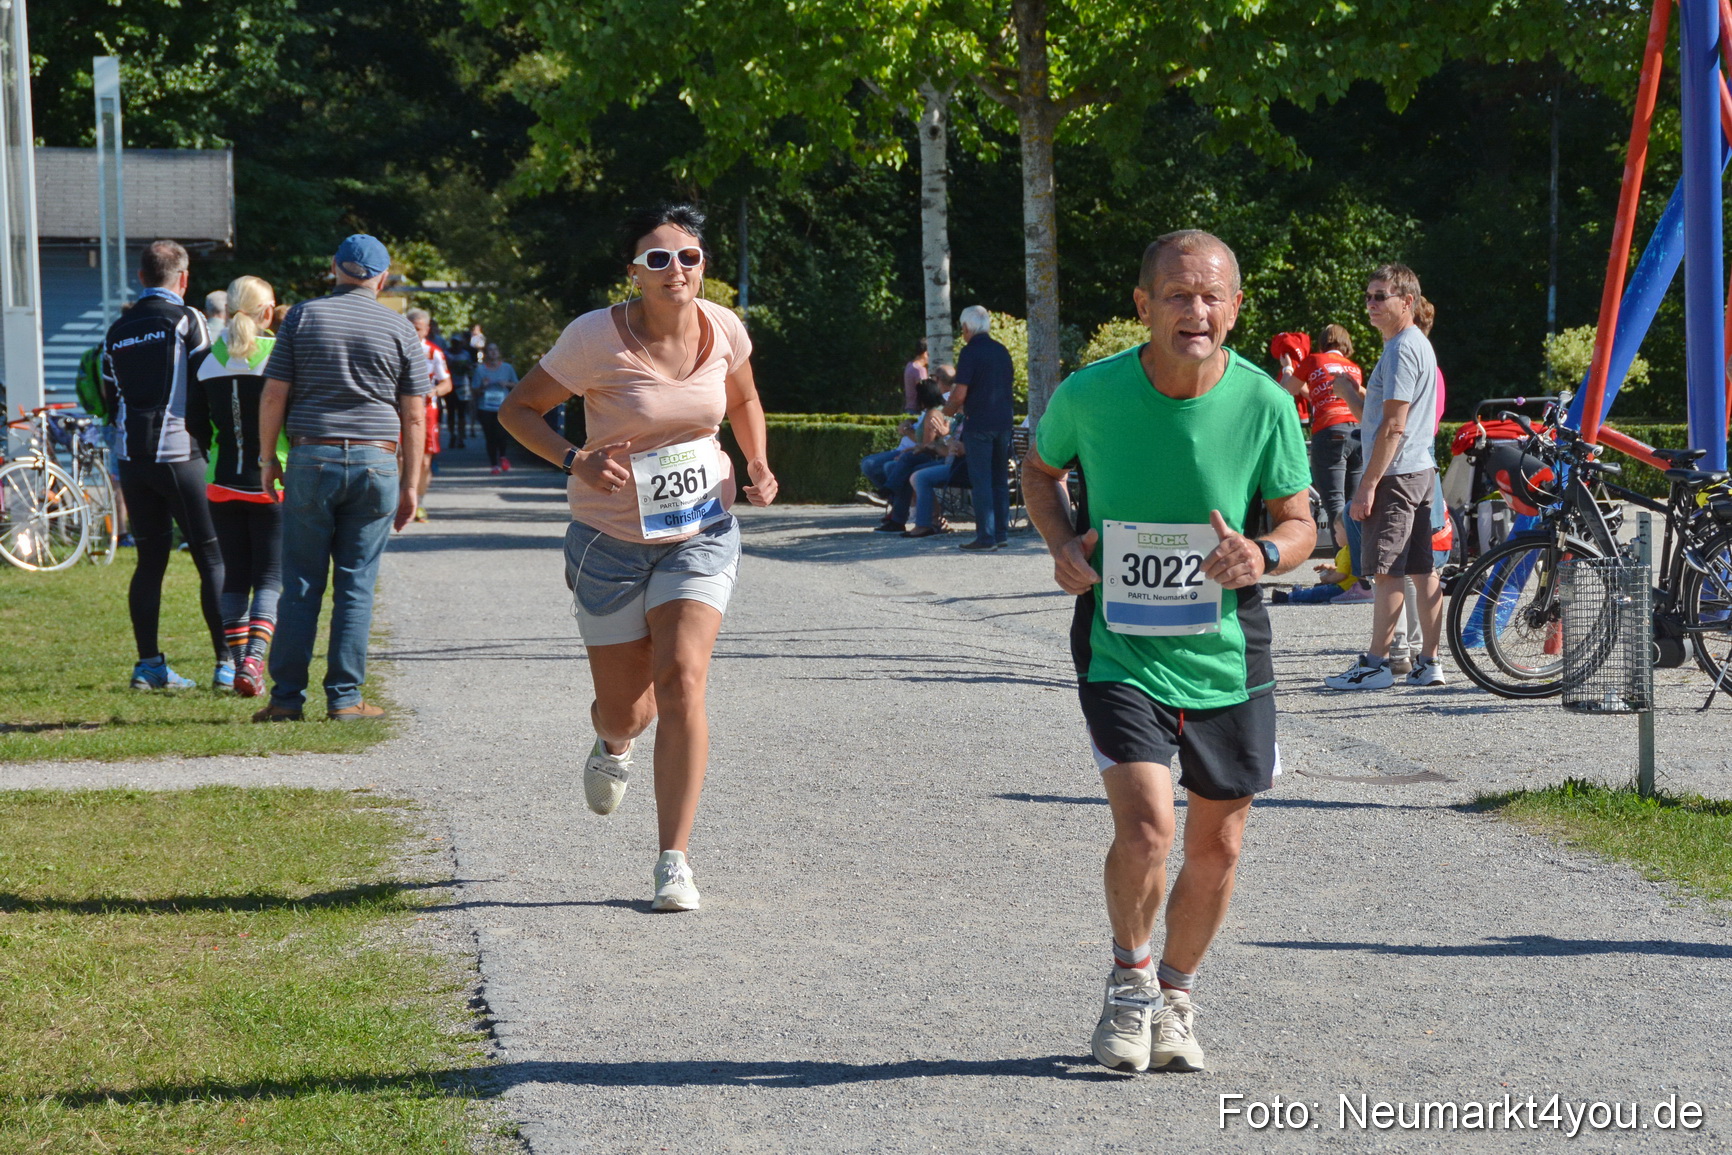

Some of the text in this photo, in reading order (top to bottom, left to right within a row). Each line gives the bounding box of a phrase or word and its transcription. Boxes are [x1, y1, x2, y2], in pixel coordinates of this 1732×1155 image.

[112, 331, 165, 350] NALINI
[659, 450, 696, 467] BOCK
[651, 464, 708, 501] 2361
[659, 496, 703, 510] PARTL Neumarkt
[664, 507, 707, 526] Christine
[1137, 533, 1189, 545] BOCK
[1121, 553, 1204, 588] 3022
[1127, 591, 1152, 600] PARTL
